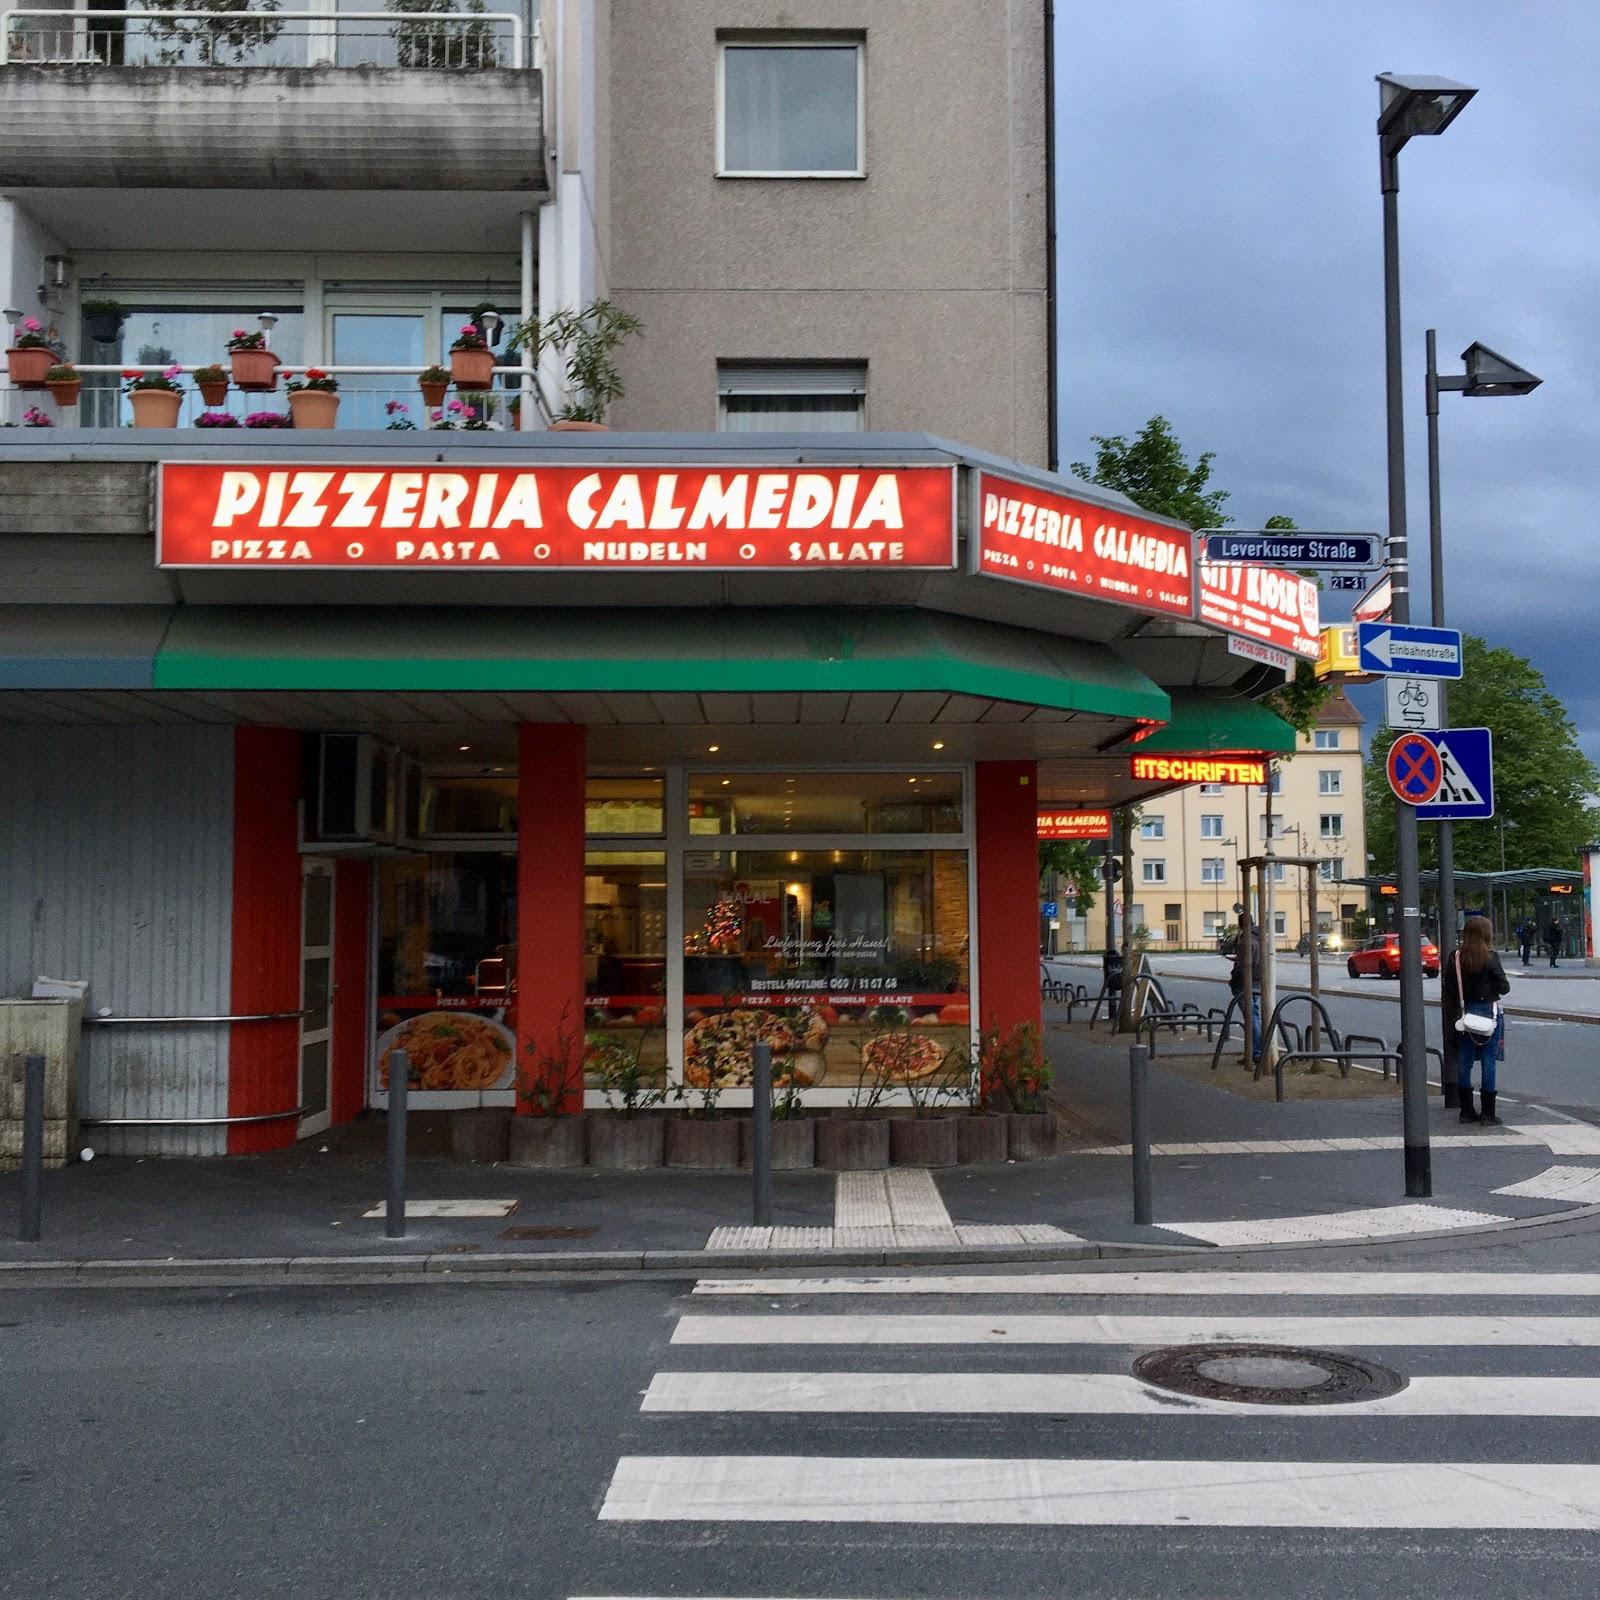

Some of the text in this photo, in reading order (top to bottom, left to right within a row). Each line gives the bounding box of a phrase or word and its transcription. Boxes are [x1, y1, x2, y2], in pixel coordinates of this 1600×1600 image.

[211, 471, 905, 531] PIZZERIA CALMEDIA
[983, 493, 1189, 578] PIZZERIA CALMEDIA
[210, 540, 905, 561] PIZZA PASTA NUDELN SALATE
[1221, 539, 1357, 559] Leverkuser Straße
[983, 548, 1019, 568] PIZZA
[1043, 563, 1078, 582] PASTA
[1100, 576, 1139, 596] NUDELN
[1246, 565, 1299, 617] KIOSK
[1331, 576, 1367, 590] 21-31
[1388, 643, 1456, 660] Einbahnstraße
[1055, 815, 1107, 827] CALMEDIA
[762, 935, 822, 953] Lieferung
[825, 935, 848, 952] frei
[830, 978, 850, 989] 069
[741, 996, 771, 1005] PIZZA
[828, 996, 866, 1005] NUDELN
[878, 995, 914, 1005] SALATE
